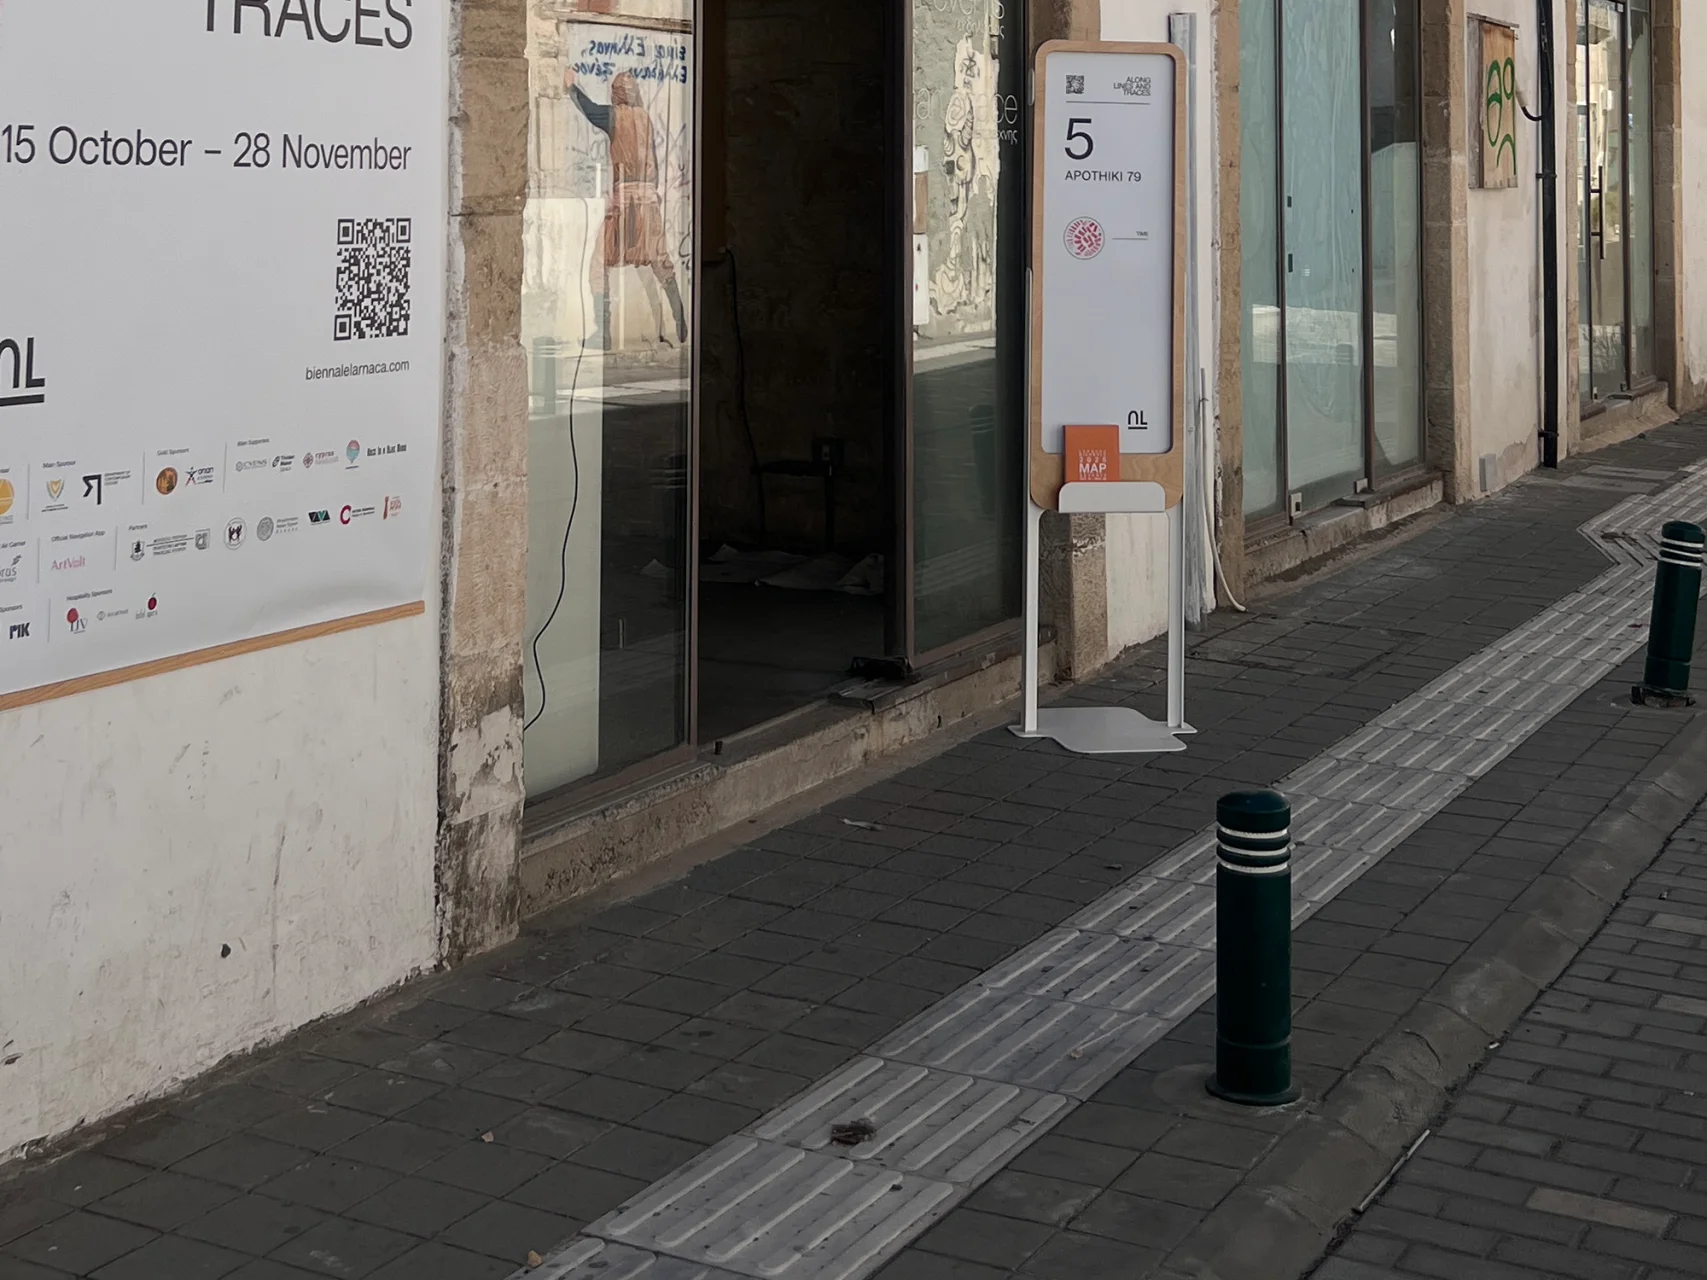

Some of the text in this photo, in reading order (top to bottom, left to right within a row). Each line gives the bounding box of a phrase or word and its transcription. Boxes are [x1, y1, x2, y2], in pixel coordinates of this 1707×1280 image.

[1113, 82, 1133, 90] LINES
[1, 124, 36, 165] 15
[48, 125, 192, 166] October
[233, 132, 271, 168] 28
[281, 133, 412, 170] November
[1064, 117, 1094, 160] 5
[1064, 170, 1142, 182] APOTHIKI 79
[305, 359, 410, 381] biennalelarnaca.com
[1079, 463, 1107, 473] MAP
